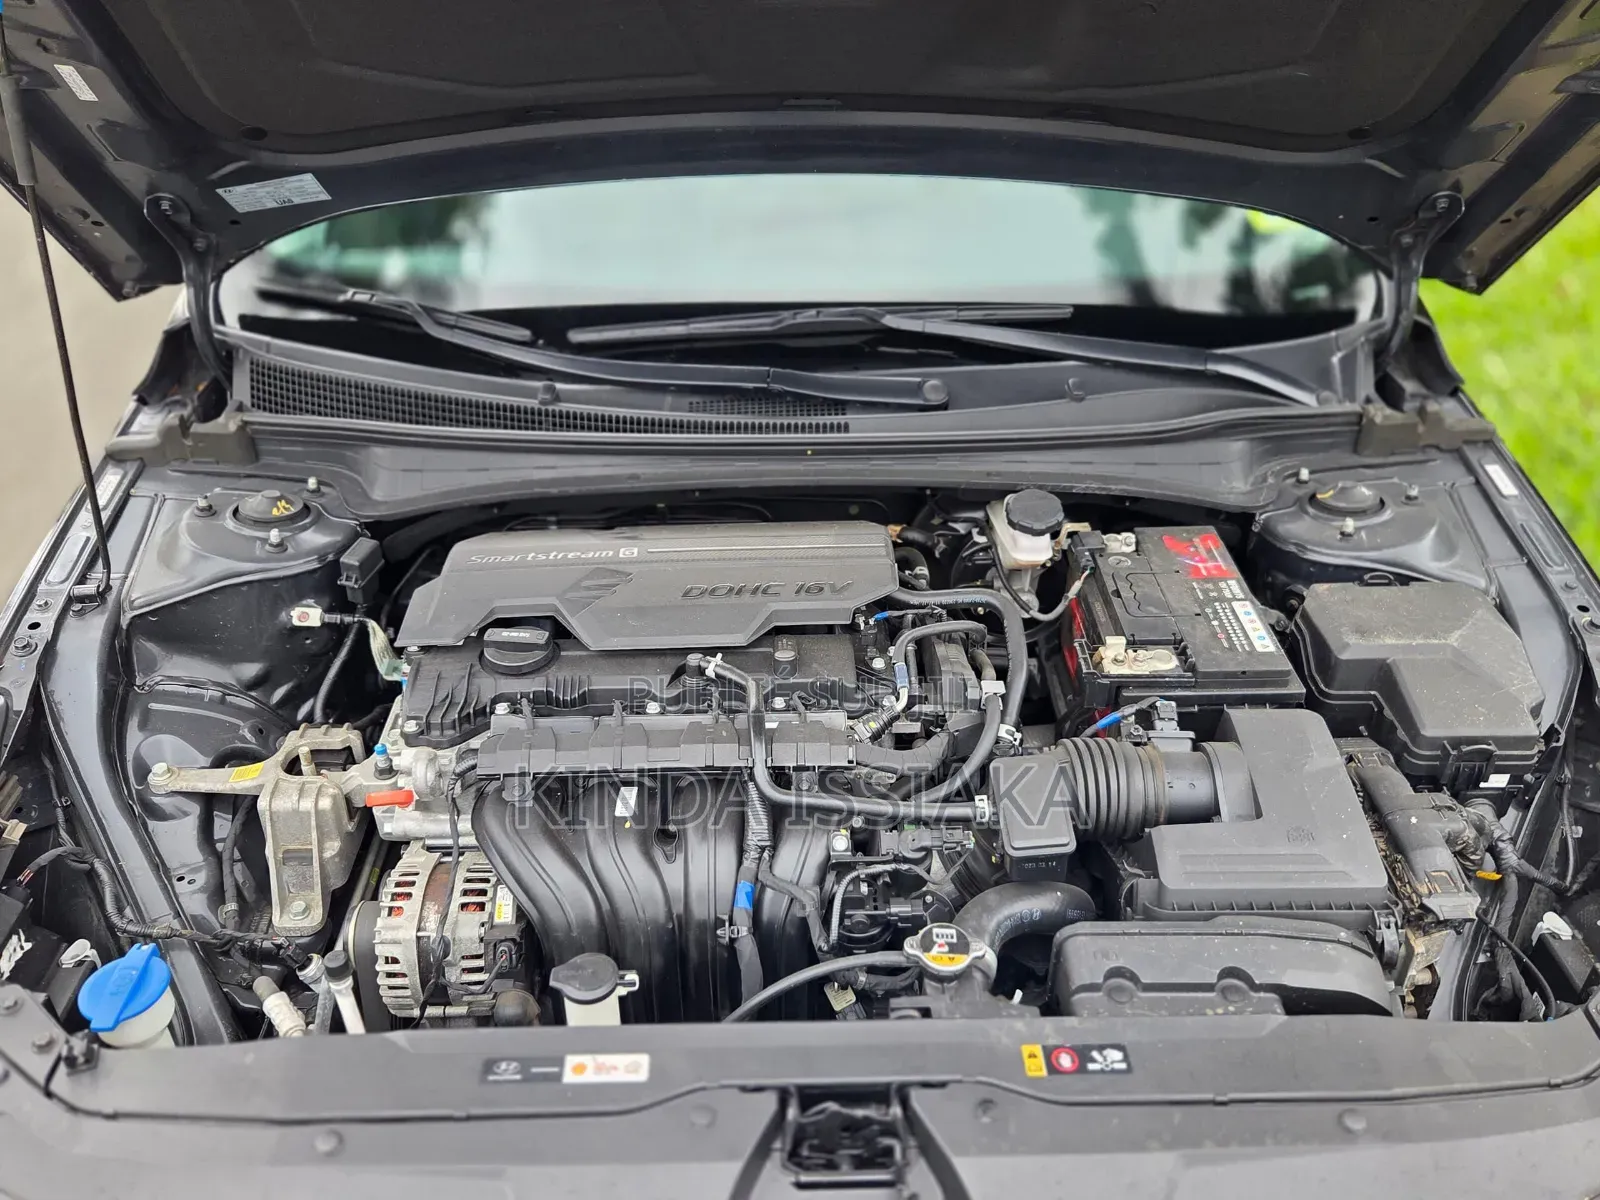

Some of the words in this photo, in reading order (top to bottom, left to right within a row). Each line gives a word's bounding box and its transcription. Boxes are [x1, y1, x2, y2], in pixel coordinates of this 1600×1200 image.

[467, 549, 613, 564] Smartstream
[619, 547, 638, 558] G
[681, 582, 786, 599] DOHC
[794, 580, 853, 597] 16V
